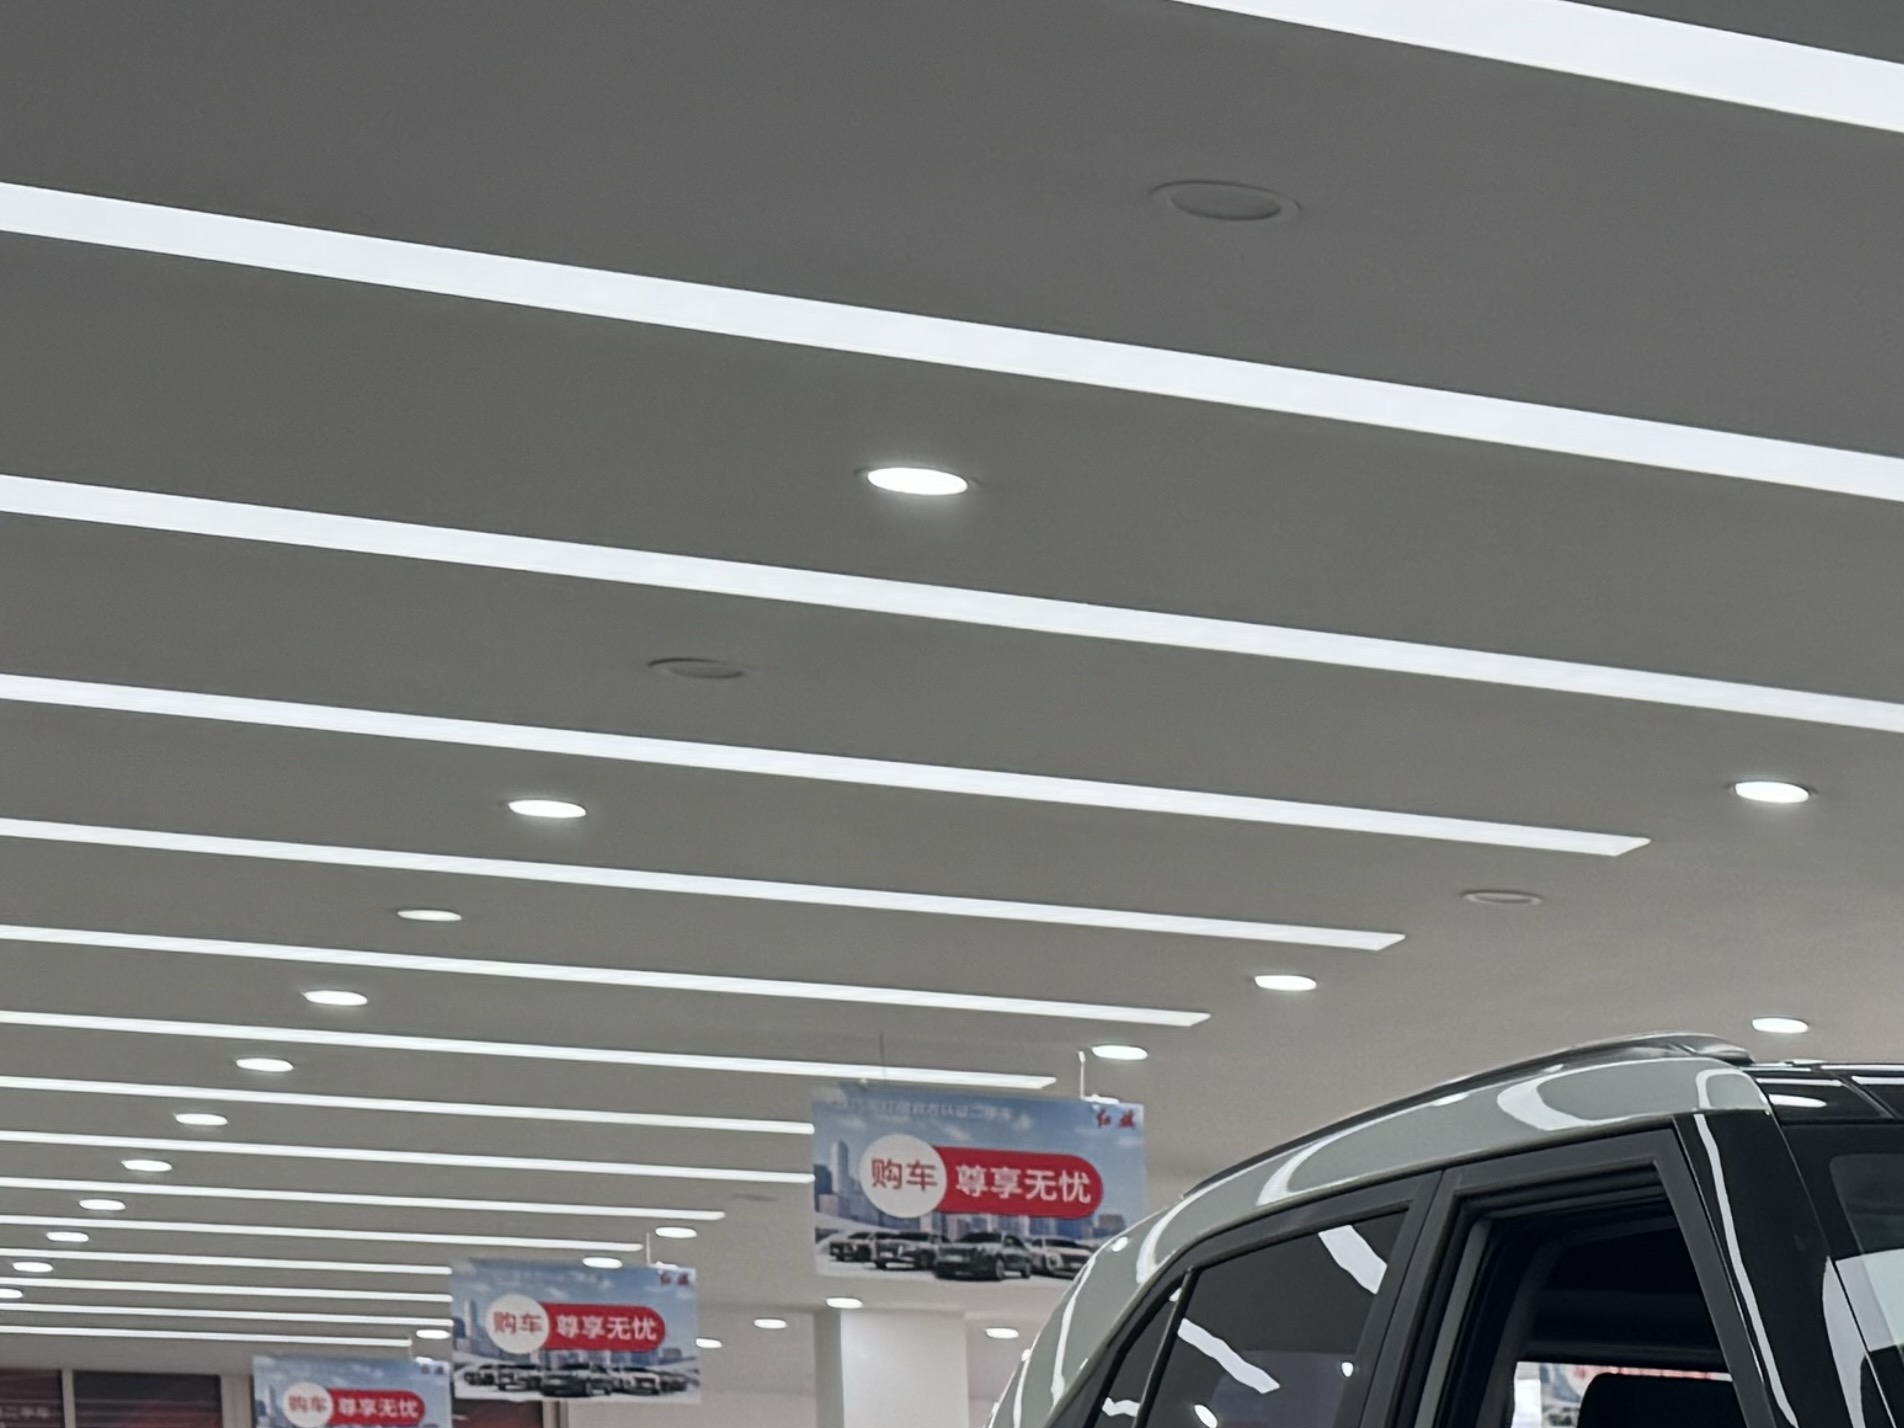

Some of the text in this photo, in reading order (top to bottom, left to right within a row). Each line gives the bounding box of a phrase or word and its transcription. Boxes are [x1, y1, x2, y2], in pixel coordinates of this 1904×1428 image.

[871, 1158, 1092, 1204] 购车 尊享无忧
[493, 1312, 657, 1341] 购车 尊享无忧
